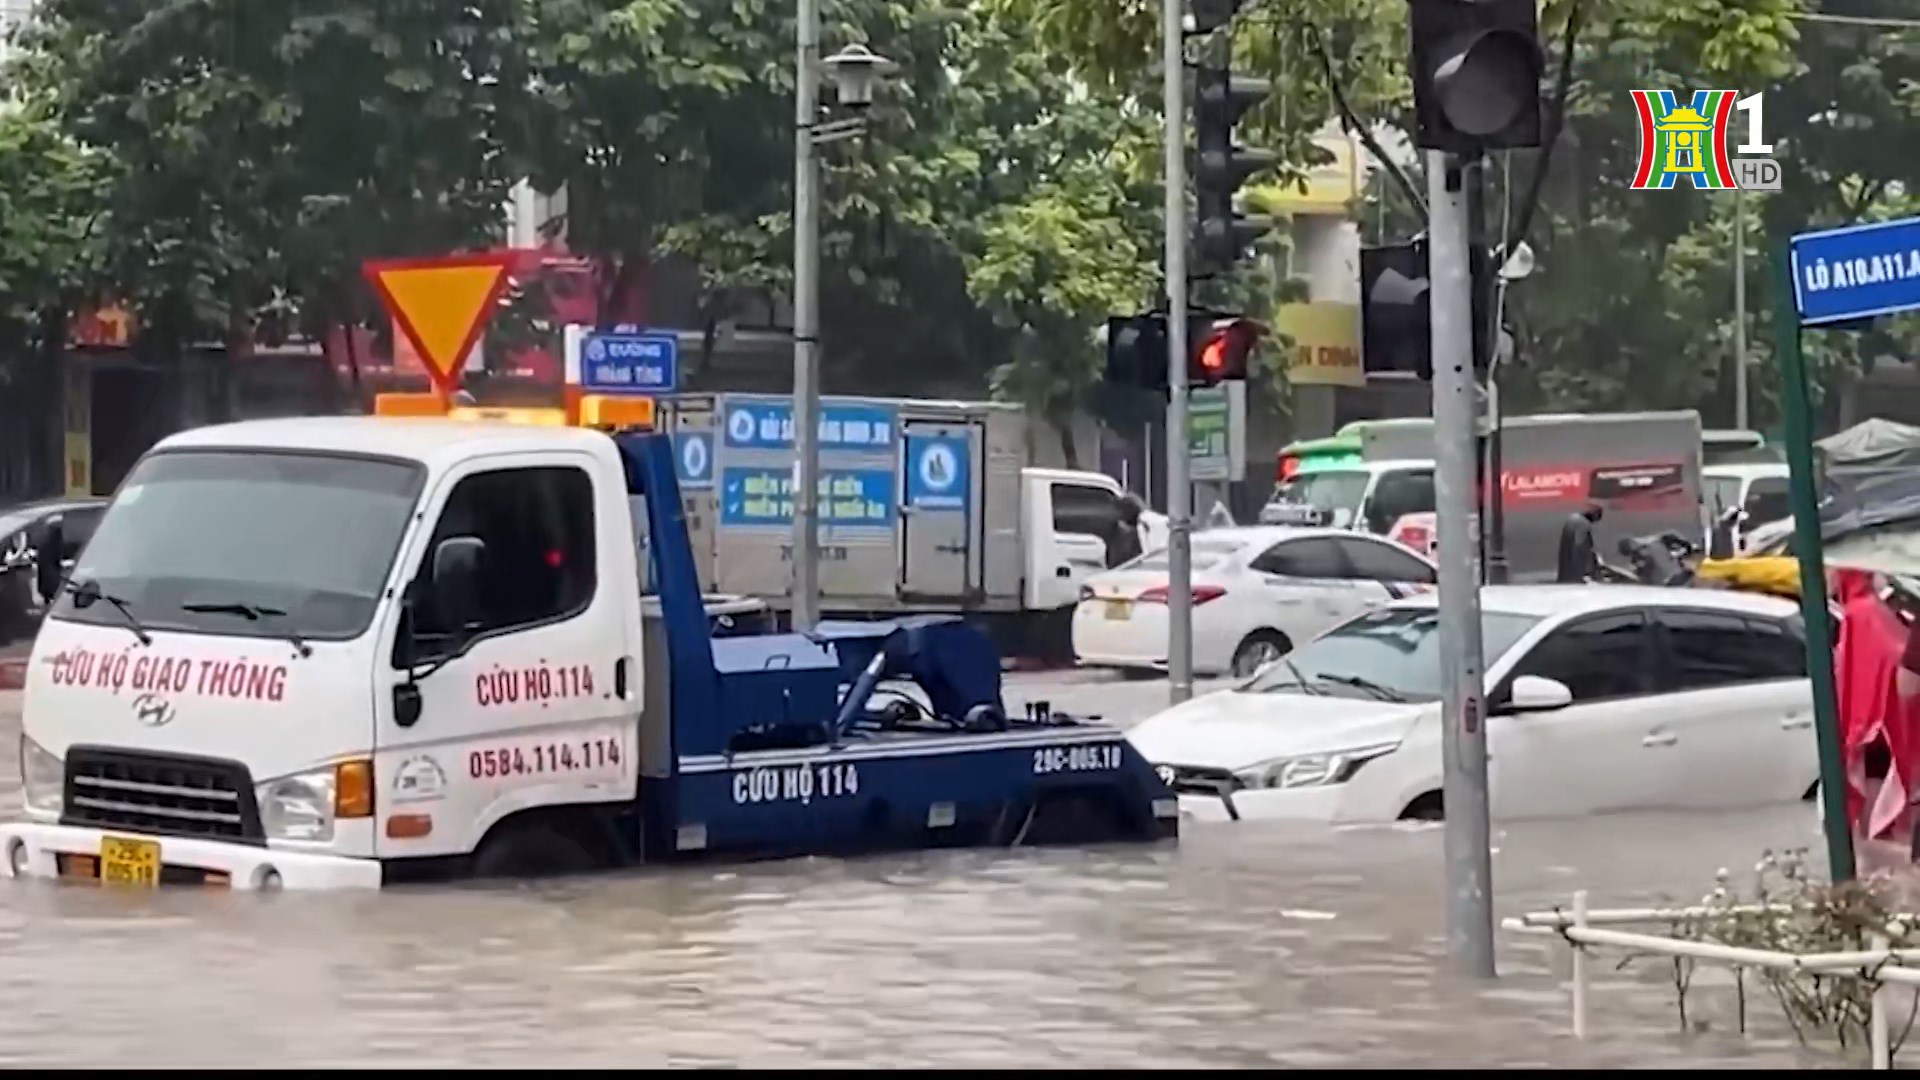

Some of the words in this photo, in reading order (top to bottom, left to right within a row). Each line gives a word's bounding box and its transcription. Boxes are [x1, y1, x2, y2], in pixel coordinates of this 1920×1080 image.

[1805, 257, 1829, 292] LÔ
[96, 647, 129, 695] HỘ
[132, 655, 192, 693] GIAO
[198, 655, 287, 702] THÔNG
[469, 738, 620, 779] 0584.114.114
[817, 763, 858, 797] 114
